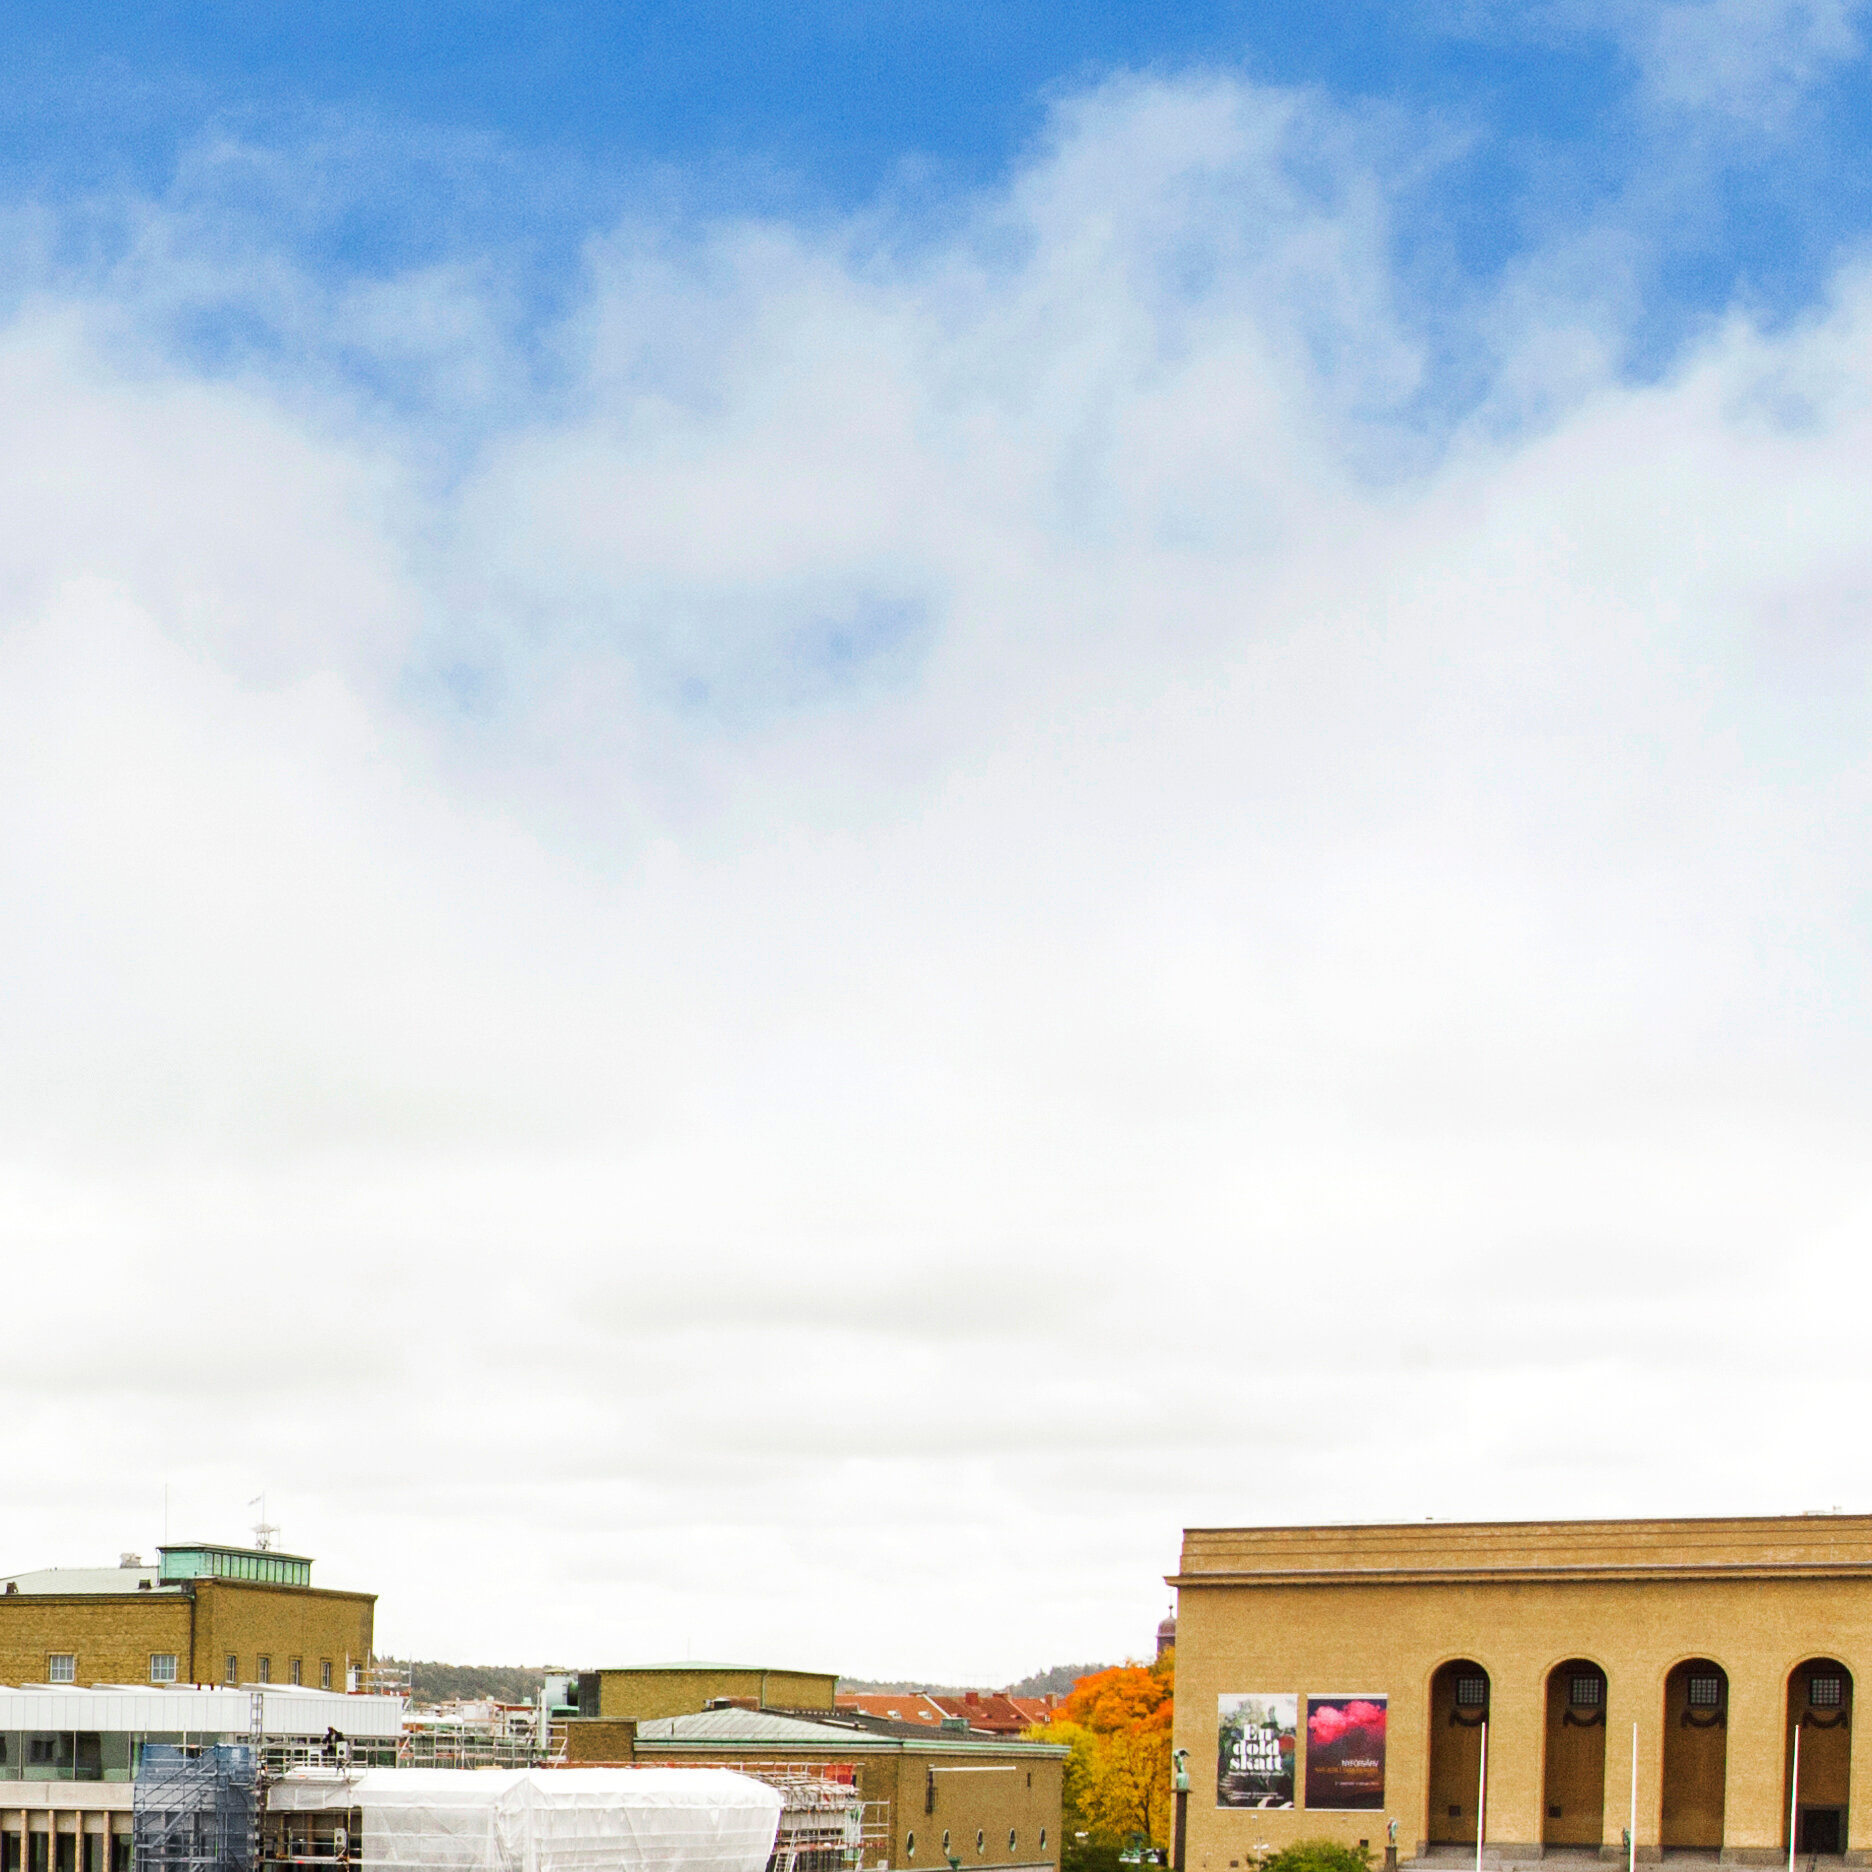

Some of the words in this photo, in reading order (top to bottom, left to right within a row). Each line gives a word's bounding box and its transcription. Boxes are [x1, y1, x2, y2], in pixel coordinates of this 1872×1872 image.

[1243, 1723, 1273, 1740] En
[1232, 1739, 1280, 1756] dold
[1229, 1755, 1283, 1771] skatt
